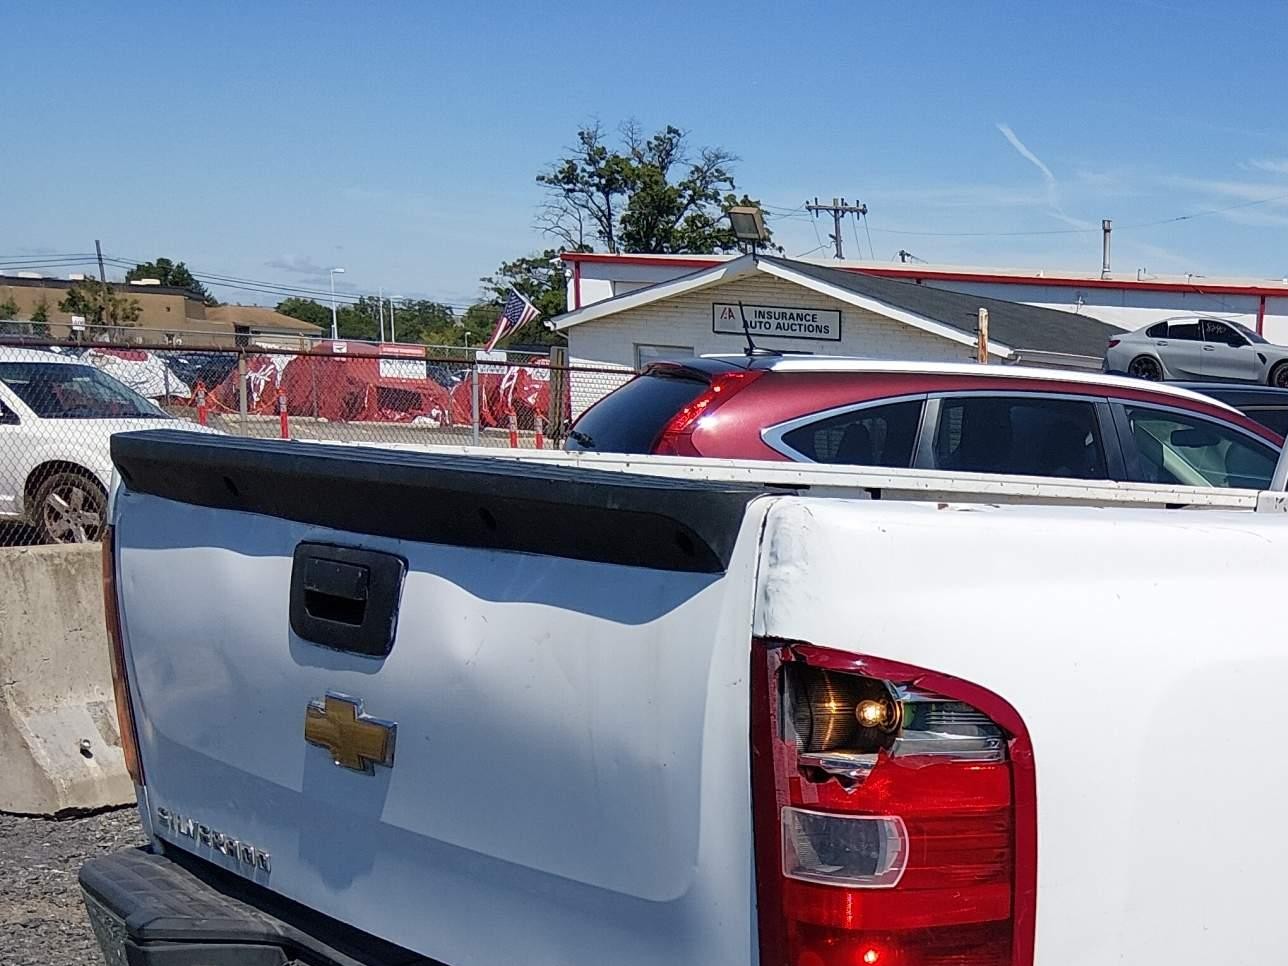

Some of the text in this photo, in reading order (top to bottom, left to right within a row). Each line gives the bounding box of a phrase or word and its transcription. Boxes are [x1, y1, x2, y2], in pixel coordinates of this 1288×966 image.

[754, 310, 818, 322] INSURANCE
[743, 320, 830, 334] AUTO AUCTIONS
